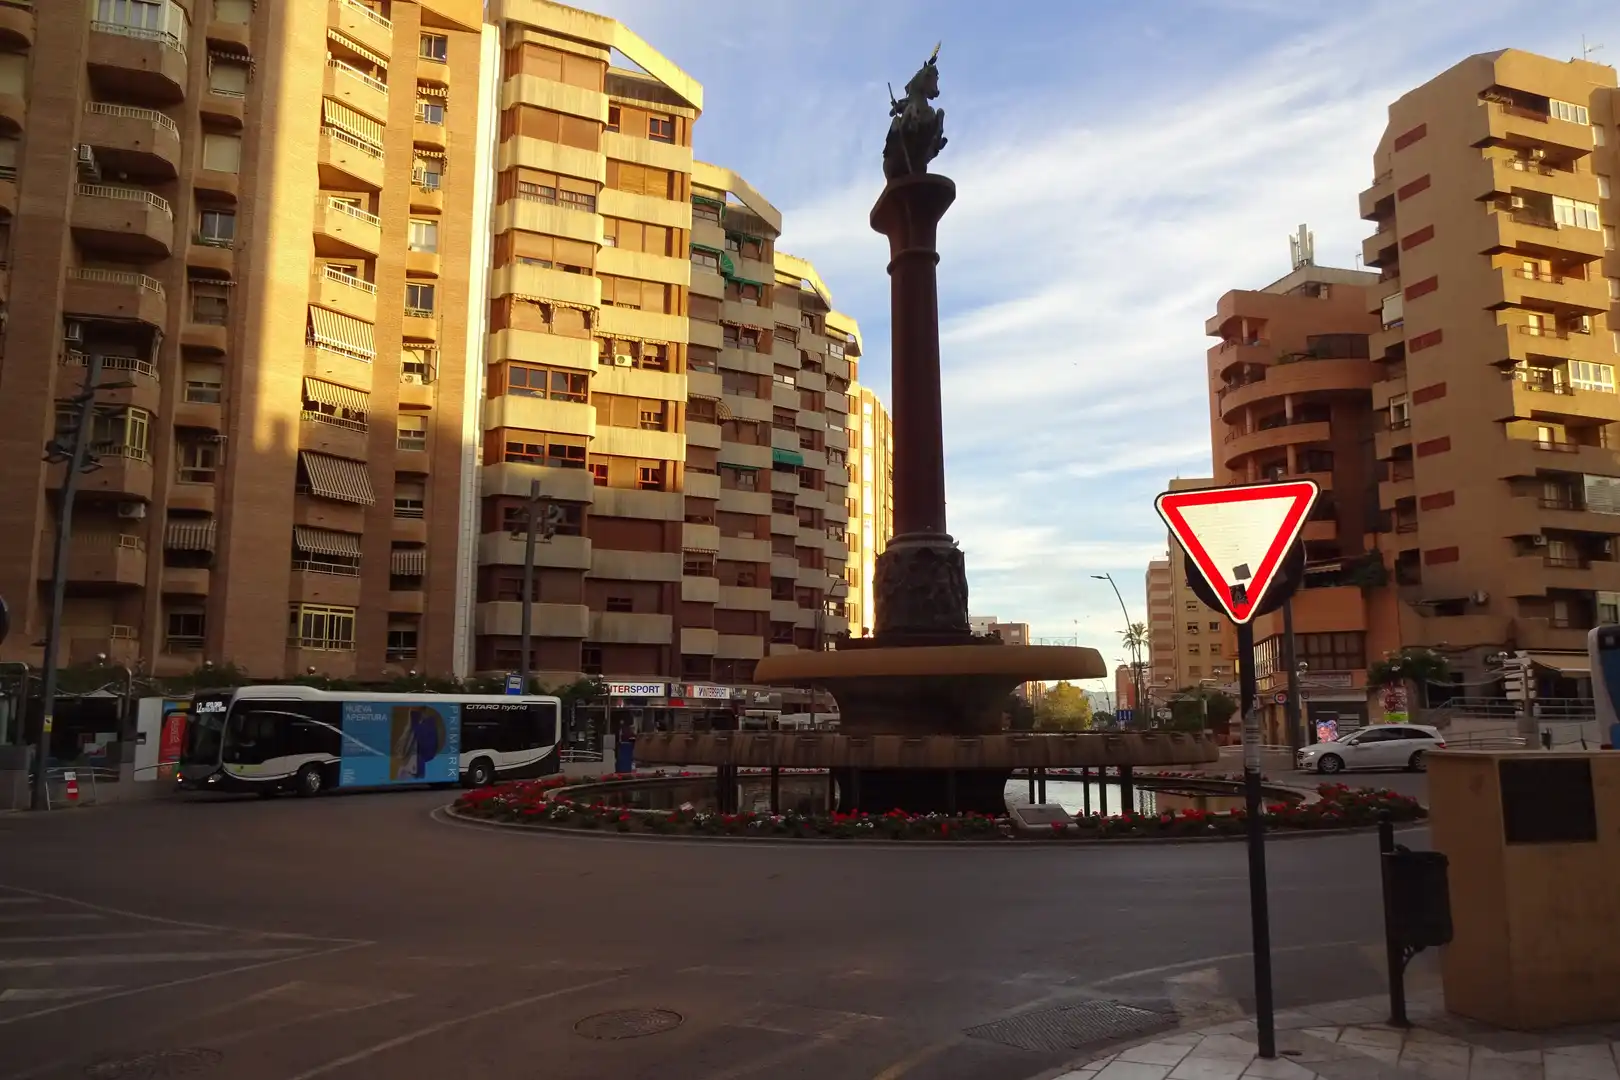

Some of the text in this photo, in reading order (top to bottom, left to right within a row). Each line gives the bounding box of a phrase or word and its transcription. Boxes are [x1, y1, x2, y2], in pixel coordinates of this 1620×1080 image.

[606, 685, 660, 694] TERSPORT
[345, 705, 372, 713] NUEVA
[345, 713, 388, 722] APERTURA
[447, 705, 459, 777] PRIMARK
